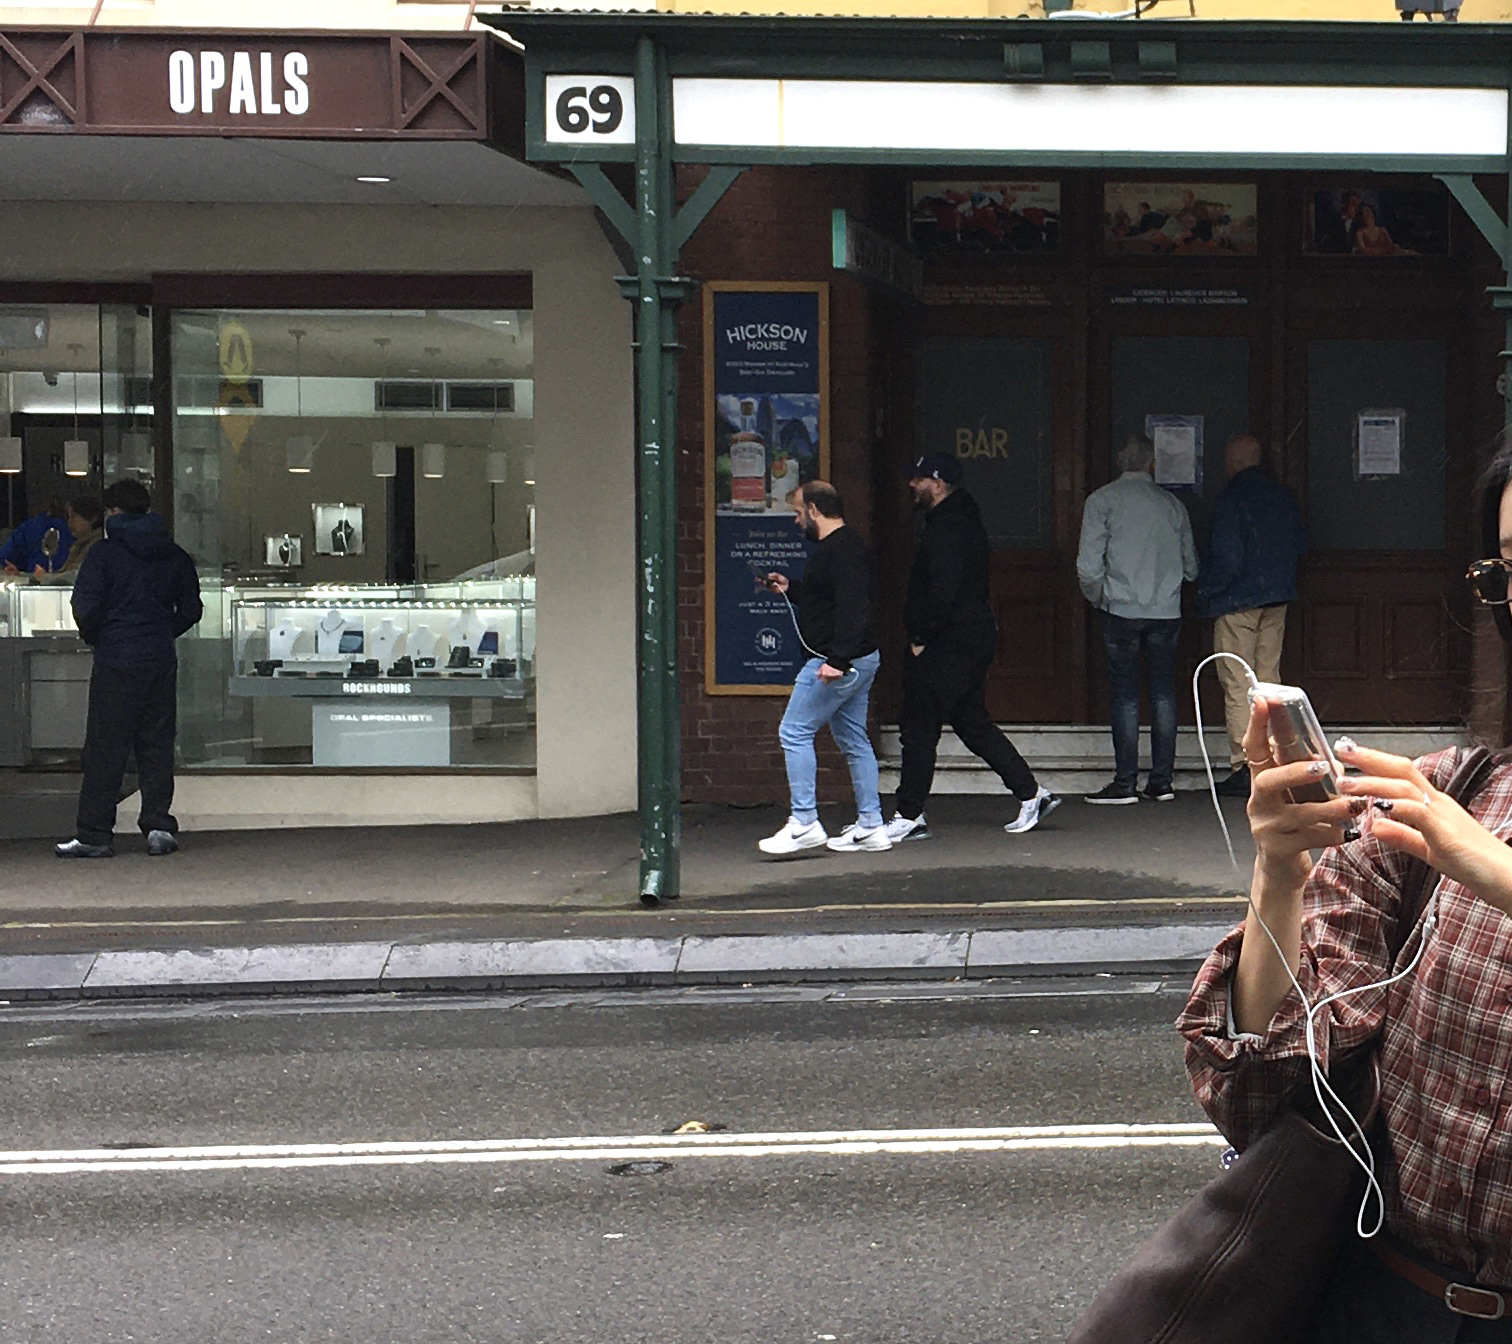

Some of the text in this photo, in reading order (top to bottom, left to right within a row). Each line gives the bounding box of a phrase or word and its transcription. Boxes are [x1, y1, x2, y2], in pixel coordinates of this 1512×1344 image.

[168, 50, 309, 115] OPALS
[555, 85, 624, 135] 69
[726, 324, 807, 344] HICKSON
[747, 341, 787, 351] HOUSE
[956, 427, 1009, 458] BAR
[342, 682, 411, 693] ROCKHOUNDS
